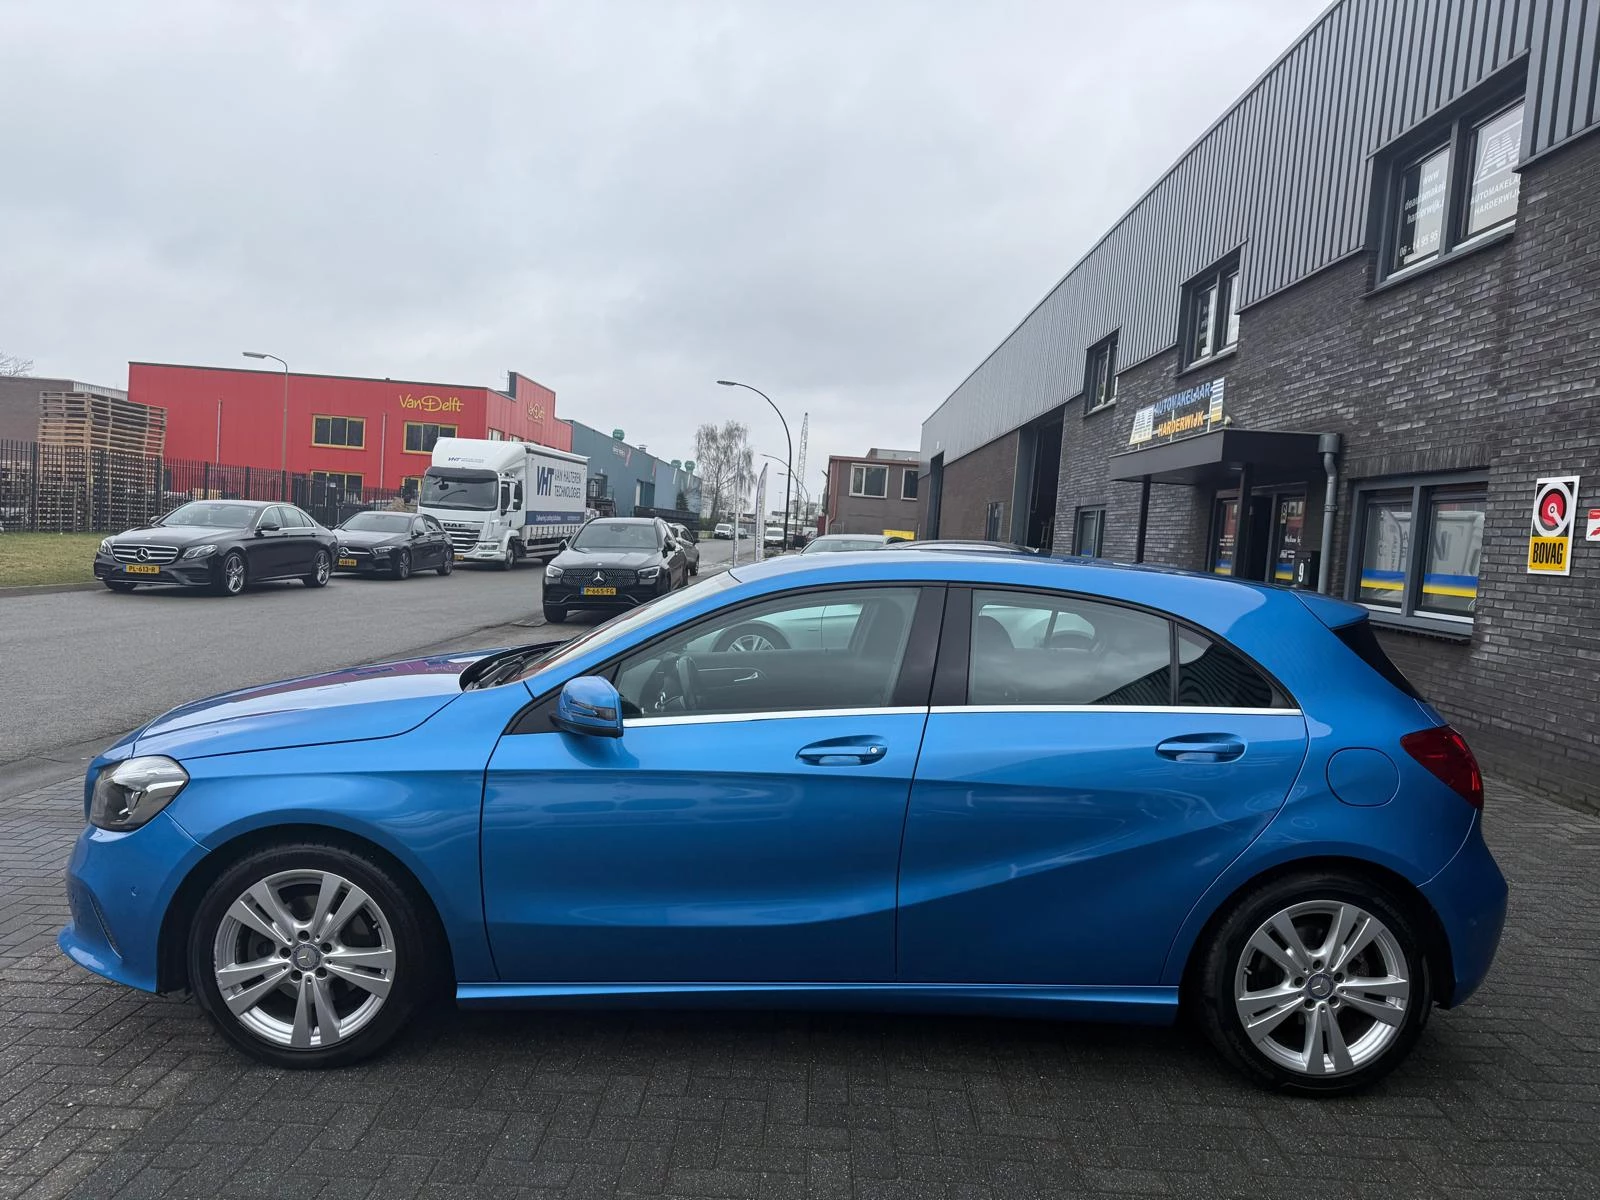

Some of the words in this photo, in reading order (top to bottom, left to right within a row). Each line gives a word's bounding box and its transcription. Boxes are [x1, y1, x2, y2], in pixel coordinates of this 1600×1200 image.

[1470, 173, 1521, 205] AUTOMAKELA
[1153, 382, 1212, 417] AUTOMAKELAAR
[1157, 411, 1204, 437] HARDERWIJK
[537, 465, 555, 497] VHT
[1532, 542, 1563, 565] BOVAG
[1298, 562, 1304, 582] 9
